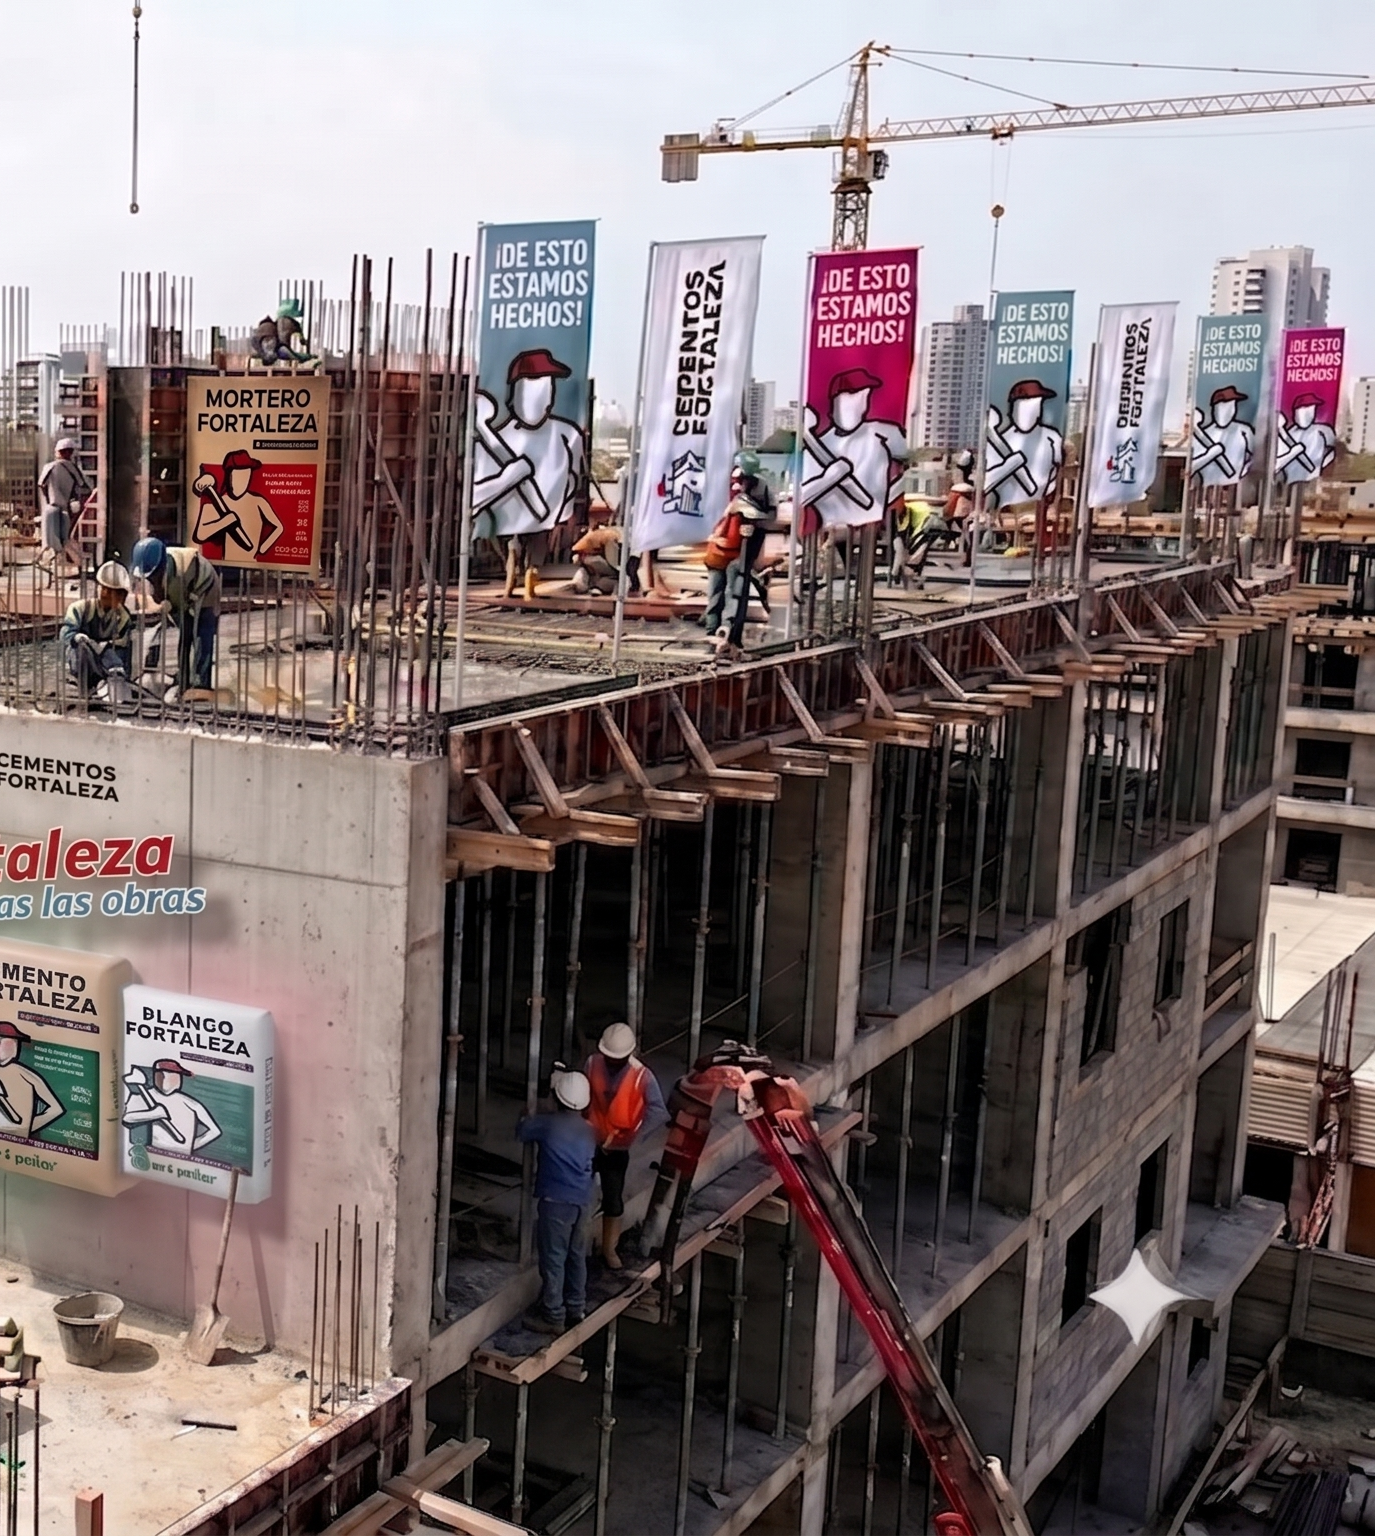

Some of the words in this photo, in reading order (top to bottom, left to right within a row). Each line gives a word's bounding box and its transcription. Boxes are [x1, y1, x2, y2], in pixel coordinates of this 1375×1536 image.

[534, 238, 588, 267] ESTO
[488, 269, 589, 299] ESTAMOS
[858, 262, 911, 291] ESTO
[490, 300, 583, 330] HECHOS!
[817, 291, 912, 321] ESTAMOS
[1030, 302, 1069, 322] ESTO
[817, 319, 905, 348] HECHOS!
[997, 323, 1068, 345] ESTAMOS
[1228, 324, 1262, 340] ESTO
[996, 345, 1064, 366] HECHOS!
[1202, 341, 1261, 358] ESTAMOS
[1310, 337, 1341, 352] ESTO
[1286, 352, 1342, 368] ESTAMOS
[206, 388, 311, 409] MORTERO
[197, 412, 318, 434] FORTALEZA
[40, 884, 93, 918] las
[100, 882, 207, 916] obras
[126, 1020, 251, 1059] FORTALEZA
